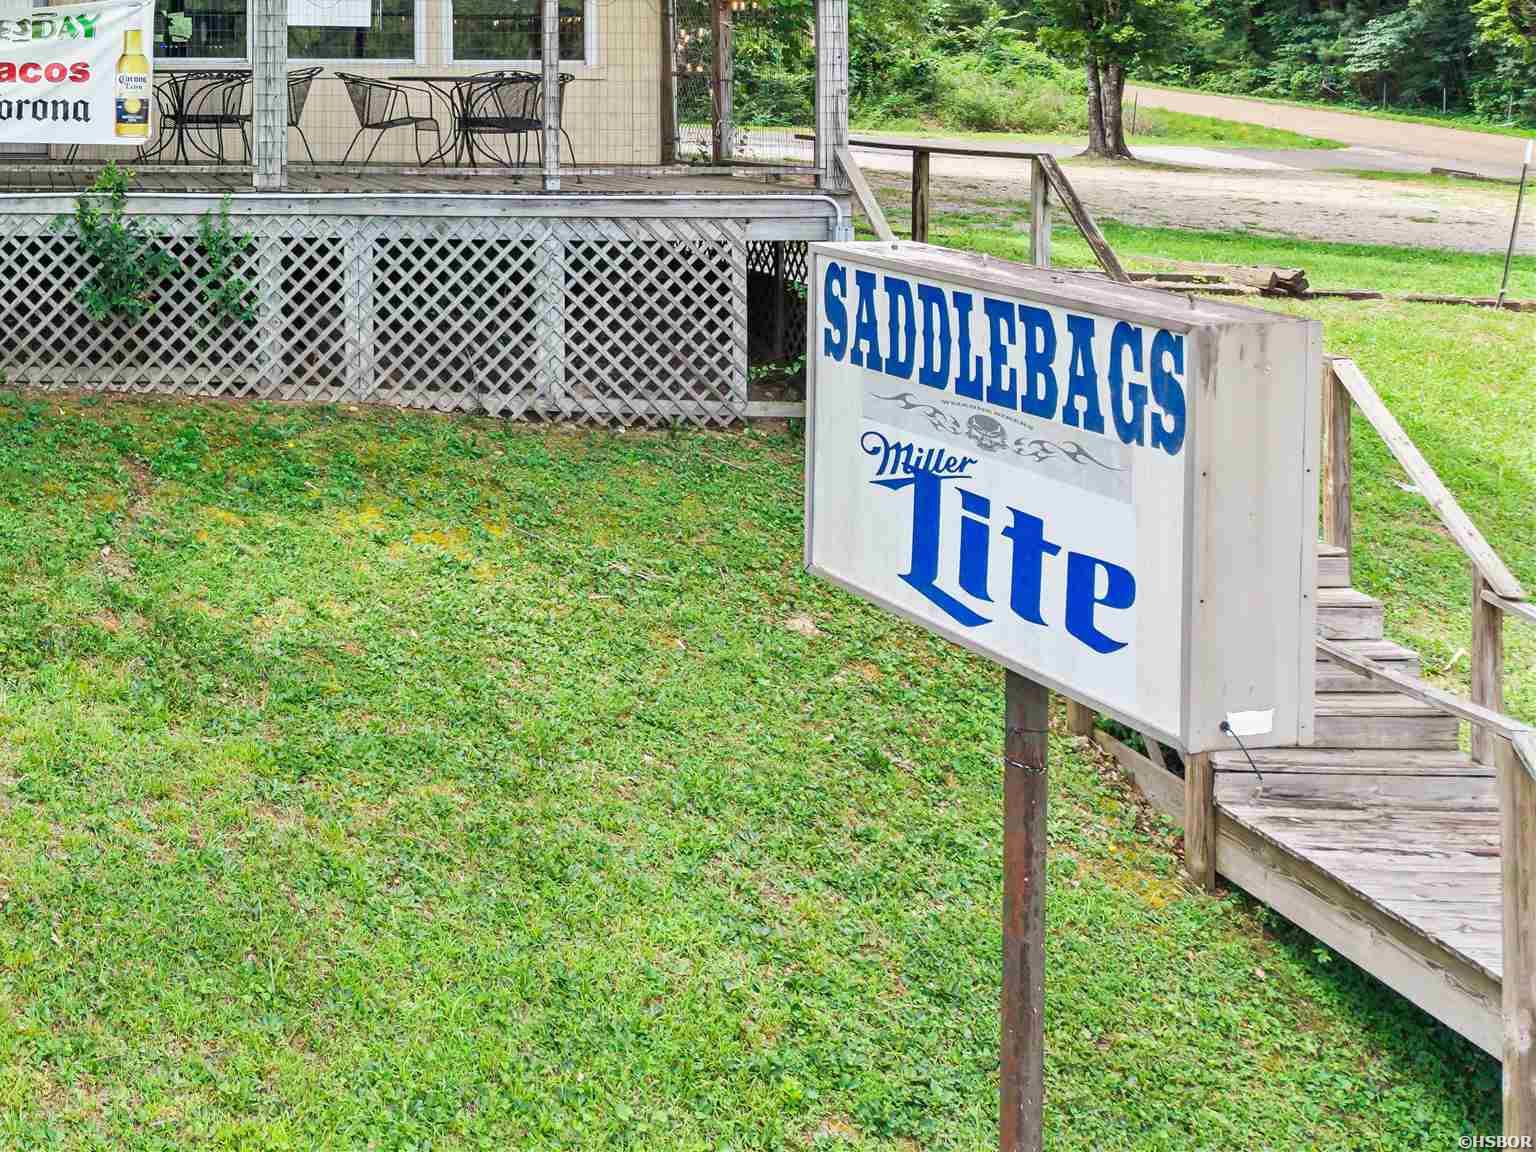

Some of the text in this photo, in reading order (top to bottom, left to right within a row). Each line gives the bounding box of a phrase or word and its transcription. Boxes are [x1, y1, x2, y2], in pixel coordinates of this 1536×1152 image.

[824, 261, 1186, 456] SADDLEBAGS
[860, 431, 978, 477] Miller
[869, 469, 1136, 655] Lite
